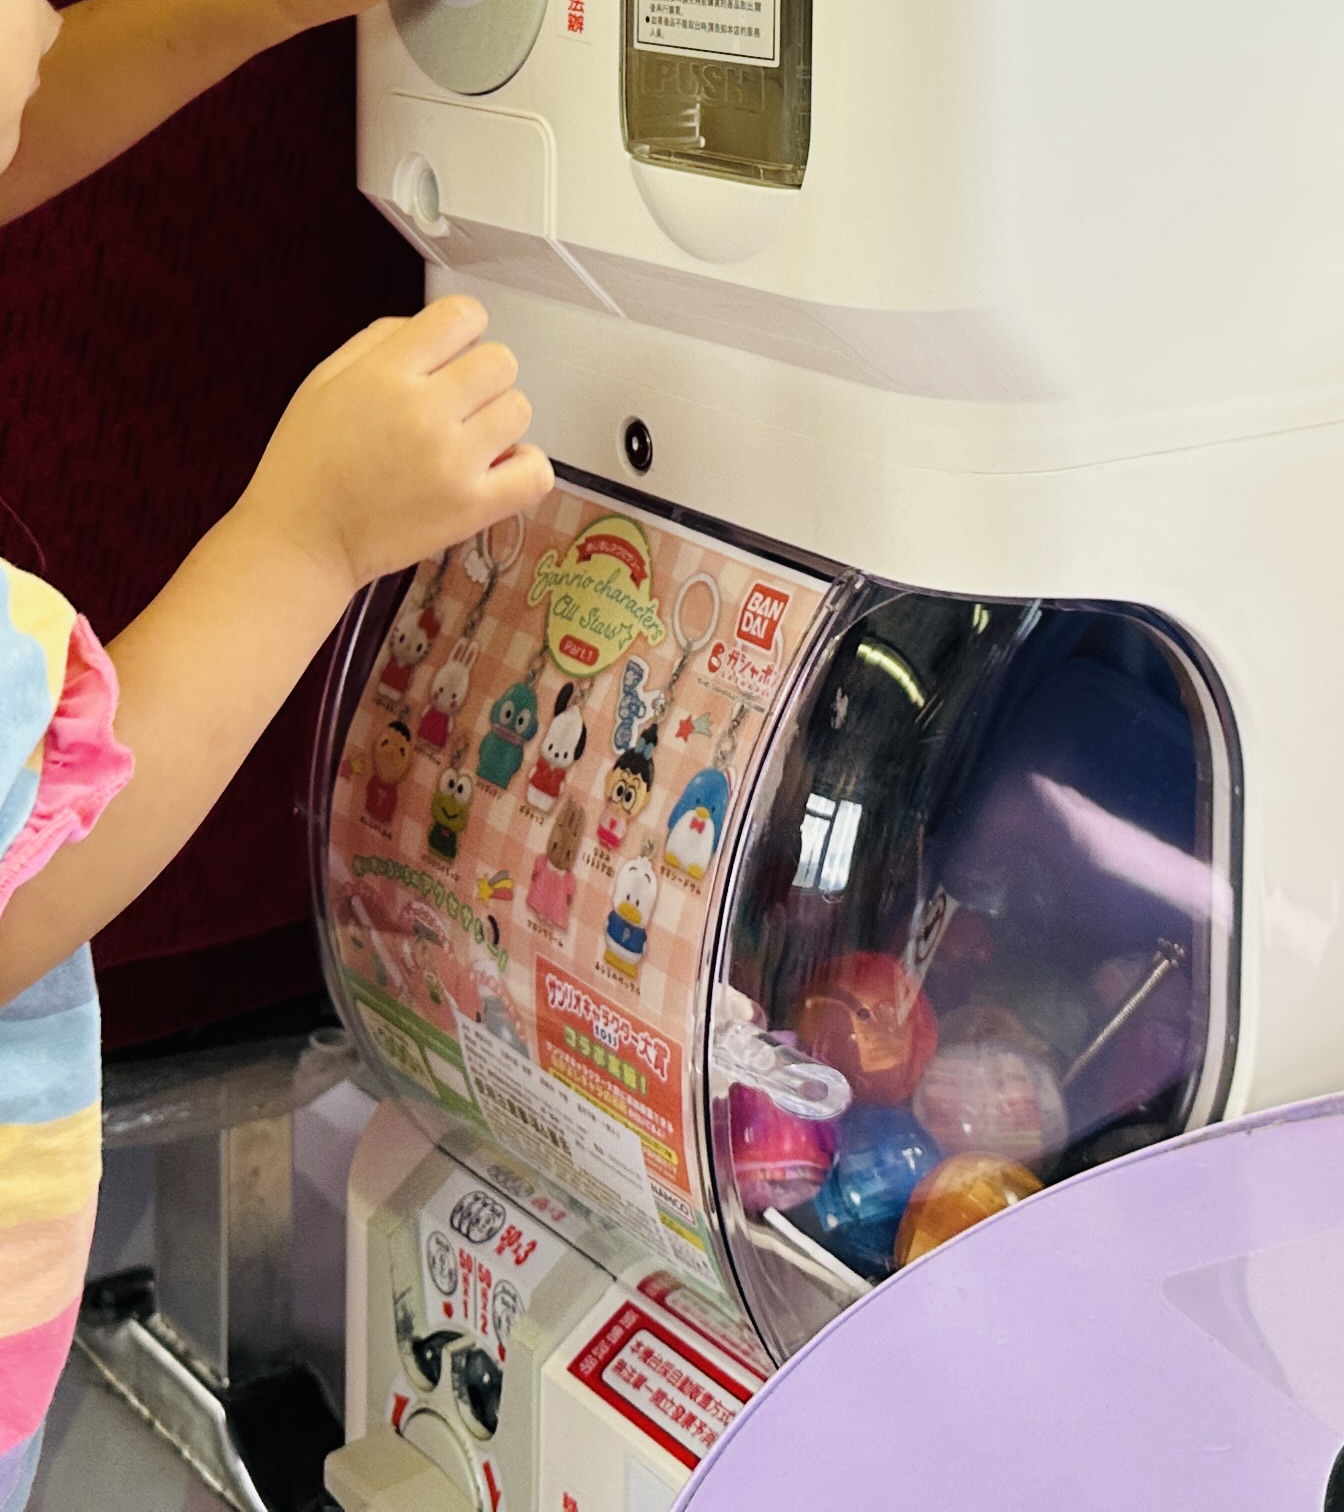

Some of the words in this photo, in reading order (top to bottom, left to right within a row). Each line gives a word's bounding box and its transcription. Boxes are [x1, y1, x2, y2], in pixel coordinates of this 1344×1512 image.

[594, 568, 664, 642] characters
[746, 592, 785, 621] BAN
[741, 613, 768, 639] DAI
